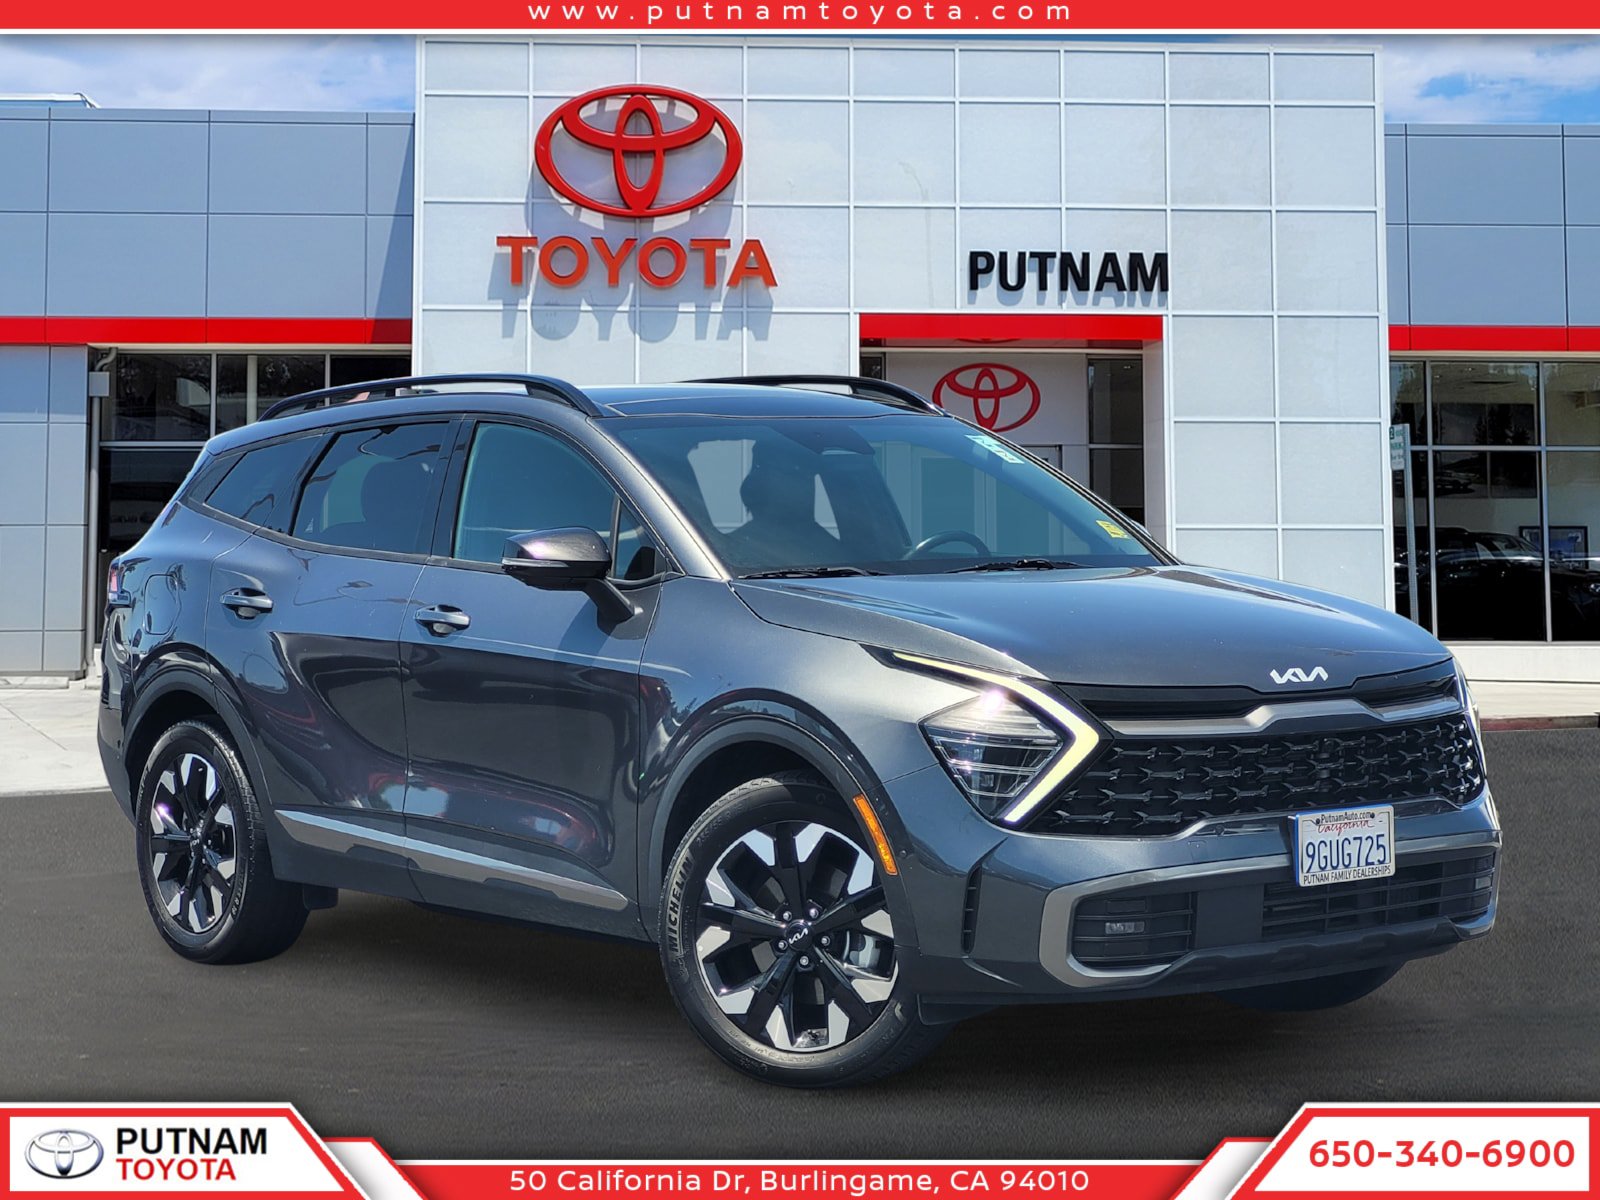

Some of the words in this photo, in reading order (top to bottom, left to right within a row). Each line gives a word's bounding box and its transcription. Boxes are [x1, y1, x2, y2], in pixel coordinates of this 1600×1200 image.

[496, 235, 777, 289] TOYOTA
[969, 251, 1169, 292] PUTNAM
[1320, 812, 1371, 823] PutnamAuto.com
[1305, 834, 1387, 874] 9GUG725
[1303, 872, 1330, 885] PUTNAM
[1330, 868, 1353, 881] FAMILY
[1352, 864, 1391, 877] DEALERSHIPS
[668, 856, 695, 953] MICHELIN
